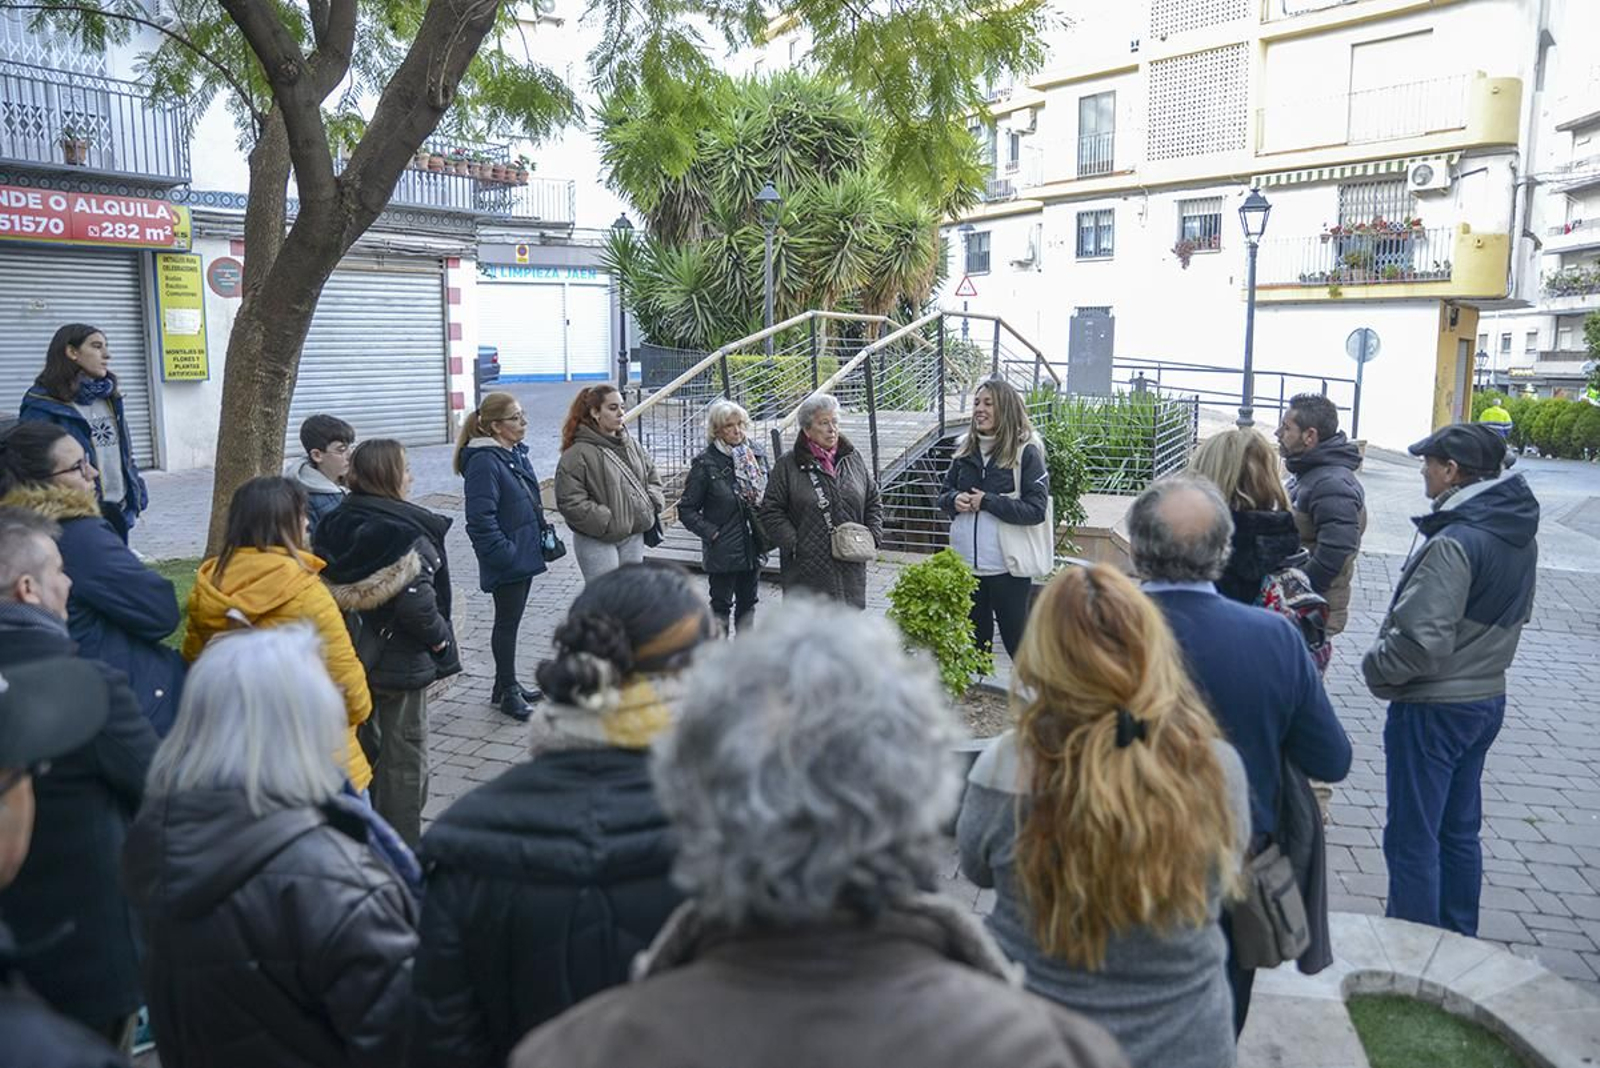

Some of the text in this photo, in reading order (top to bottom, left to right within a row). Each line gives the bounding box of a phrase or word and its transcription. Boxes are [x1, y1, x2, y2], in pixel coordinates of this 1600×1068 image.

[49, 194, 68, 211] O
[74, 198, 171, 220] ALQUILA
[0, 213, 65, 235] 51570
[101, 222, 140, 240] 282
[500, 264, 560, 279] LIMPIEZA
